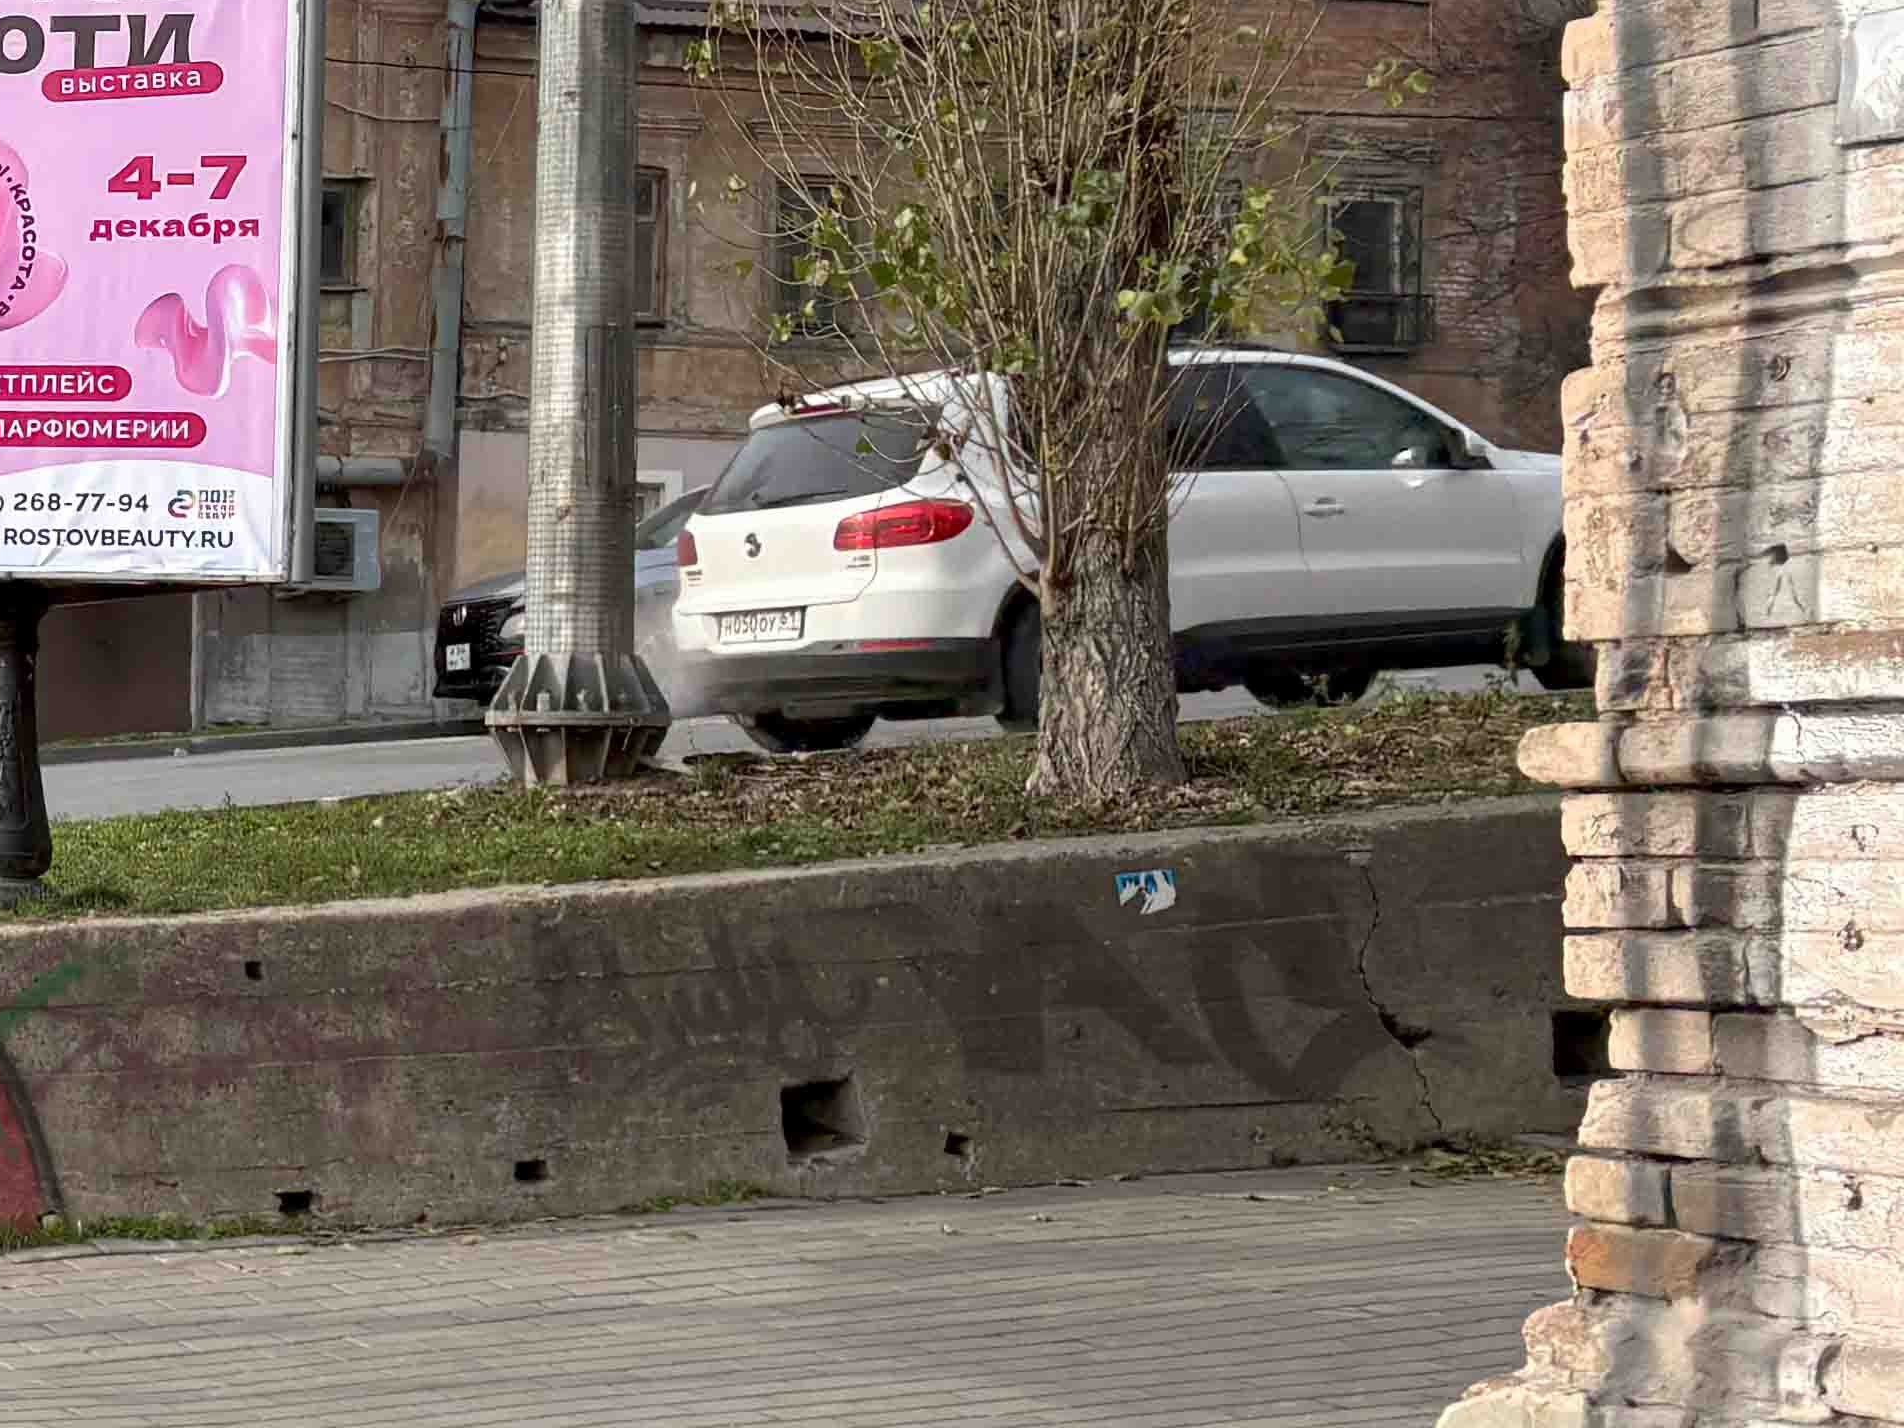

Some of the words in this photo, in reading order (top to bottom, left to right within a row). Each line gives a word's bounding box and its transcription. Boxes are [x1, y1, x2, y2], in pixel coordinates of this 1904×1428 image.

[60, 68, 202, 95] выставка
[107, 154, 249, 201] 4-7
[9, 183, 37, 290] КРАСОТА
[89, 213, 260, 242] декабря
[13, 492, 149, 512] 268-77-94
[3, 528, 234, 549] ROSTOVBEAUTY.RU
